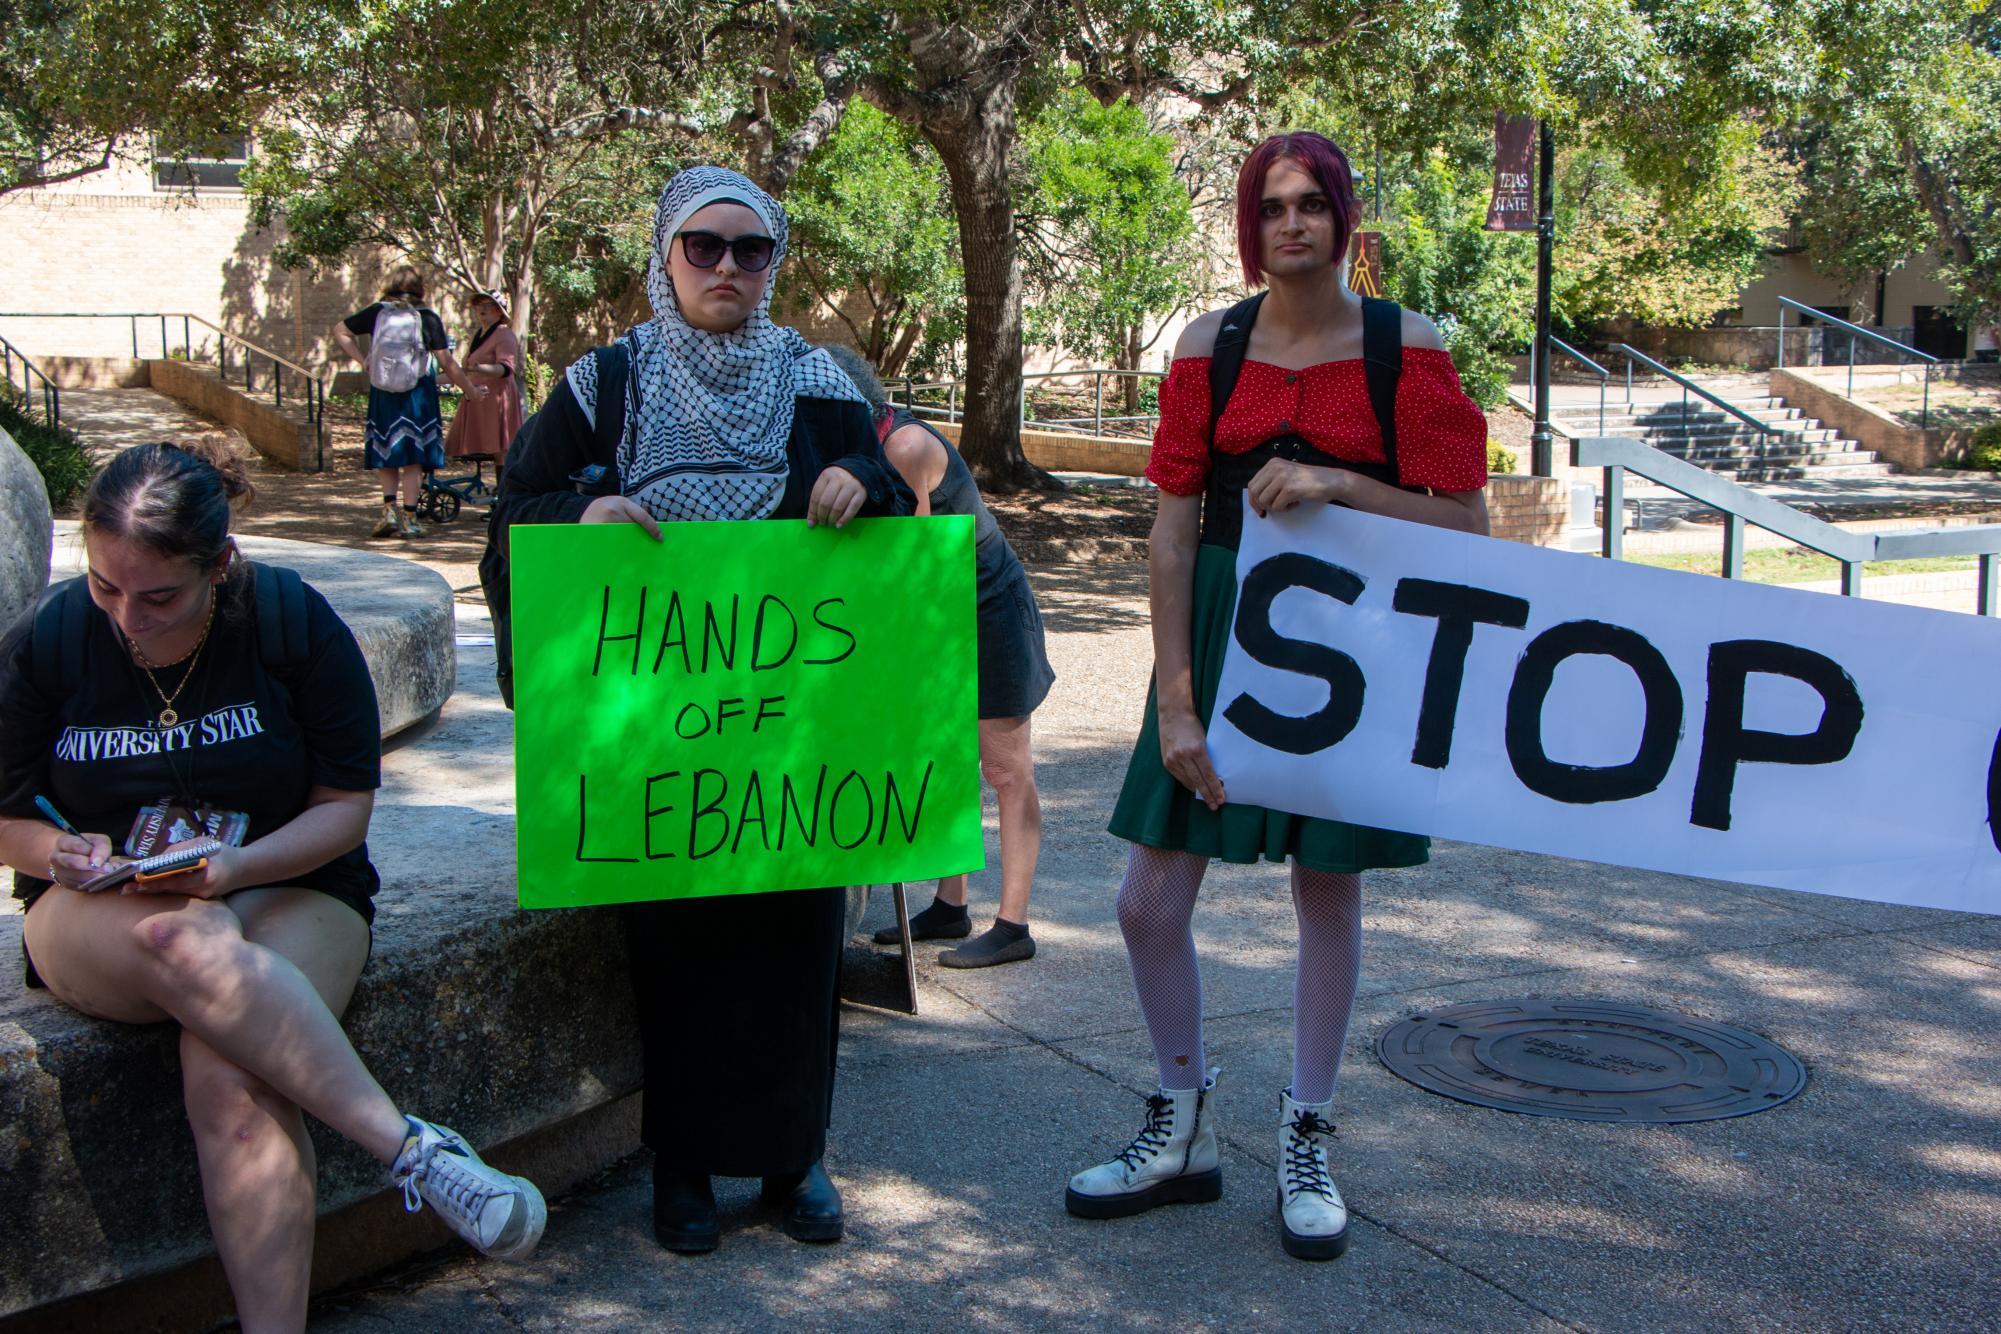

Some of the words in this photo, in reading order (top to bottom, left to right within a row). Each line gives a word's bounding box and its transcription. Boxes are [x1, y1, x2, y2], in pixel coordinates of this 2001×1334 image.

[1494, 196, 1528, 212] STATE
[1499, 172, 1528, 188] TEXAS
[592, 584, 857, 677] HANDS
[674, 695, 787, 740] OFF
[1222, 552, 1866, 832] STOP
[56, 722, 196, 761] UNIVERSITY
[200, 706, 265, 746] STAR
[575, 759, 935, 863] LEBANON
